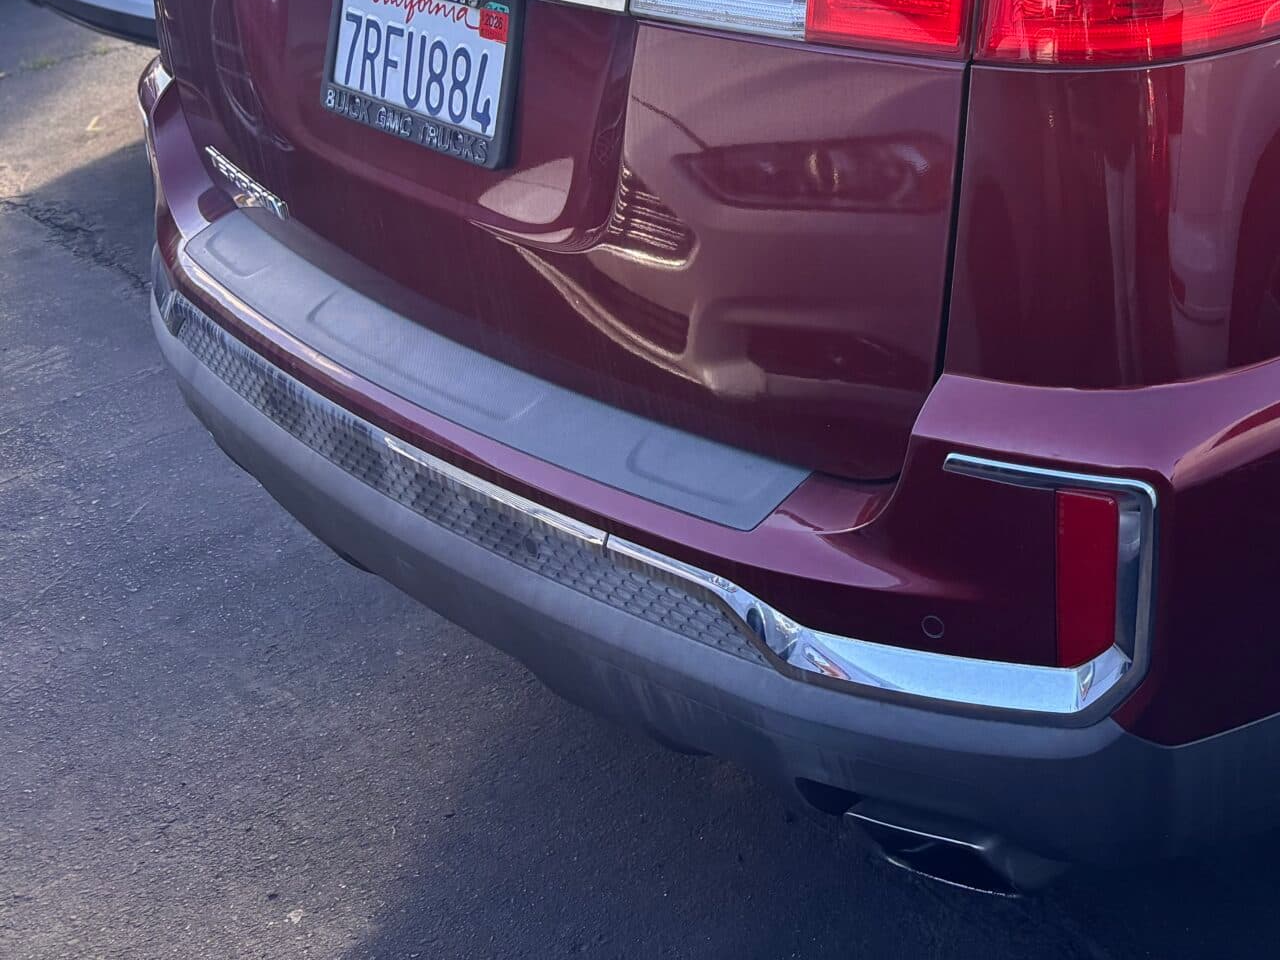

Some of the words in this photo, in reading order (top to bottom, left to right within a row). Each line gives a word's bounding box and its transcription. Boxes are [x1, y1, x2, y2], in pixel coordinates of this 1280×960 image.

[345, 12, 491, 134] 7RFU884
[326, 89, 371, 124] BUICK
[375, 106, 413, 137] GMC
[418, 122, 488, 164] TRUCKS
